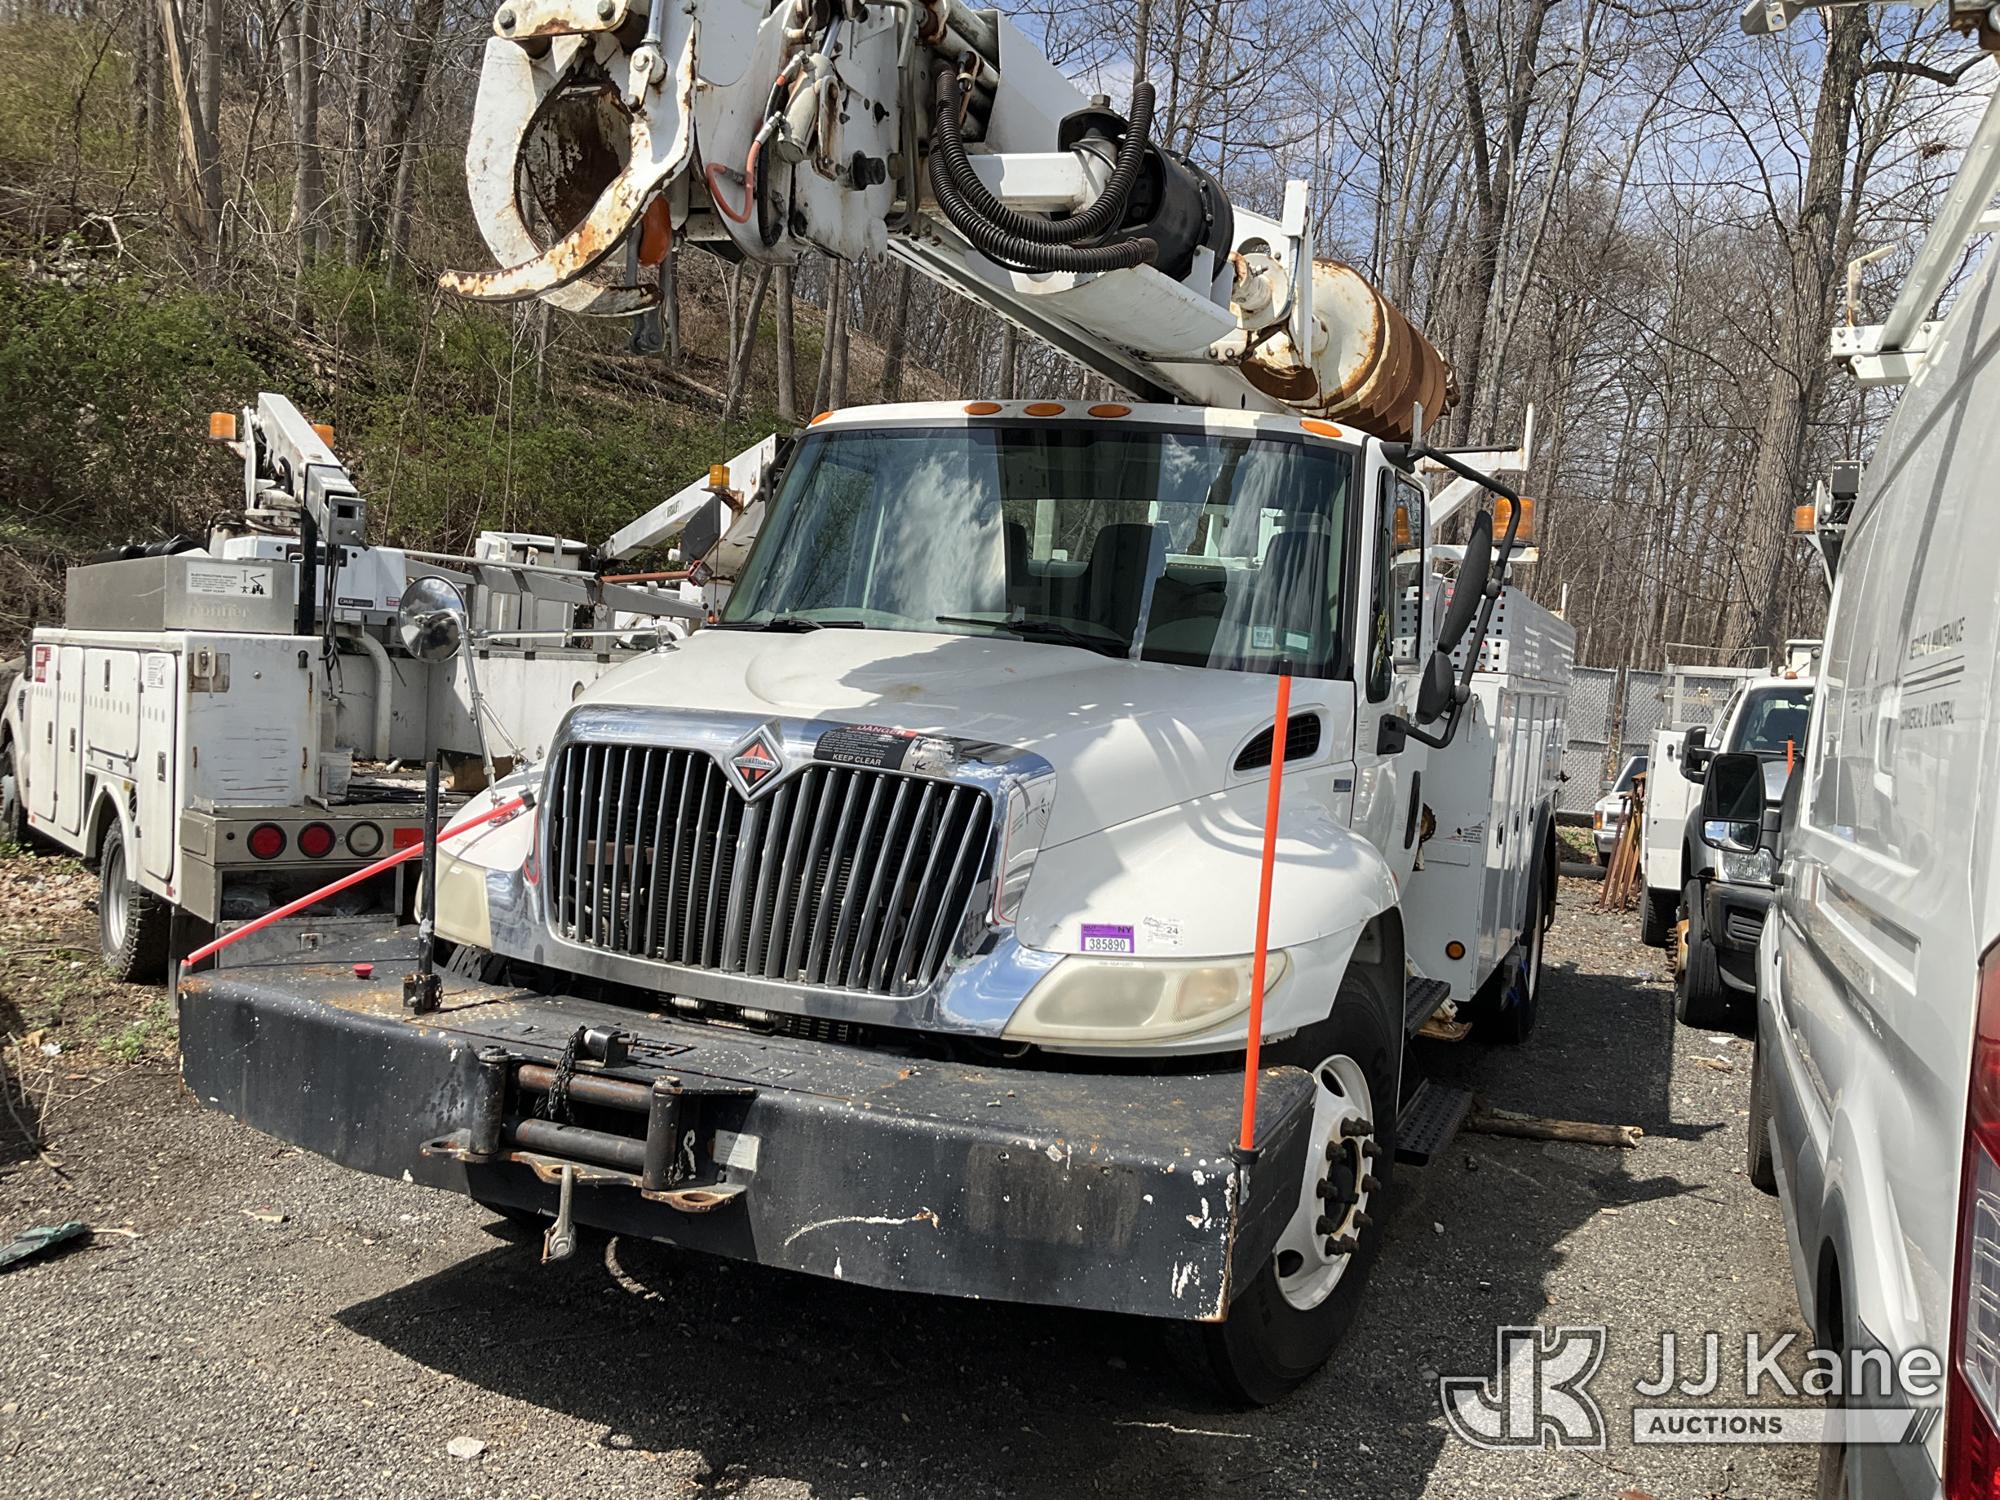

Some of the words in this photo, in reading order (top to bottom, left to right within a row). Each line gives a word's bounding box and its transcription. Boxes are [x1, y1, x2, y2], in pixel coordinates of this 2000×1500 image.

[857, 725, 907, 736] DANGER
[832, 753, 854, 761] KEEP
[854, 756, 882, 766] CLEAR
[1117, 926, 1132, 934] NY
[1167, 926, 1179, 935] 24
[1089, 938, 1126, 951] 385890
